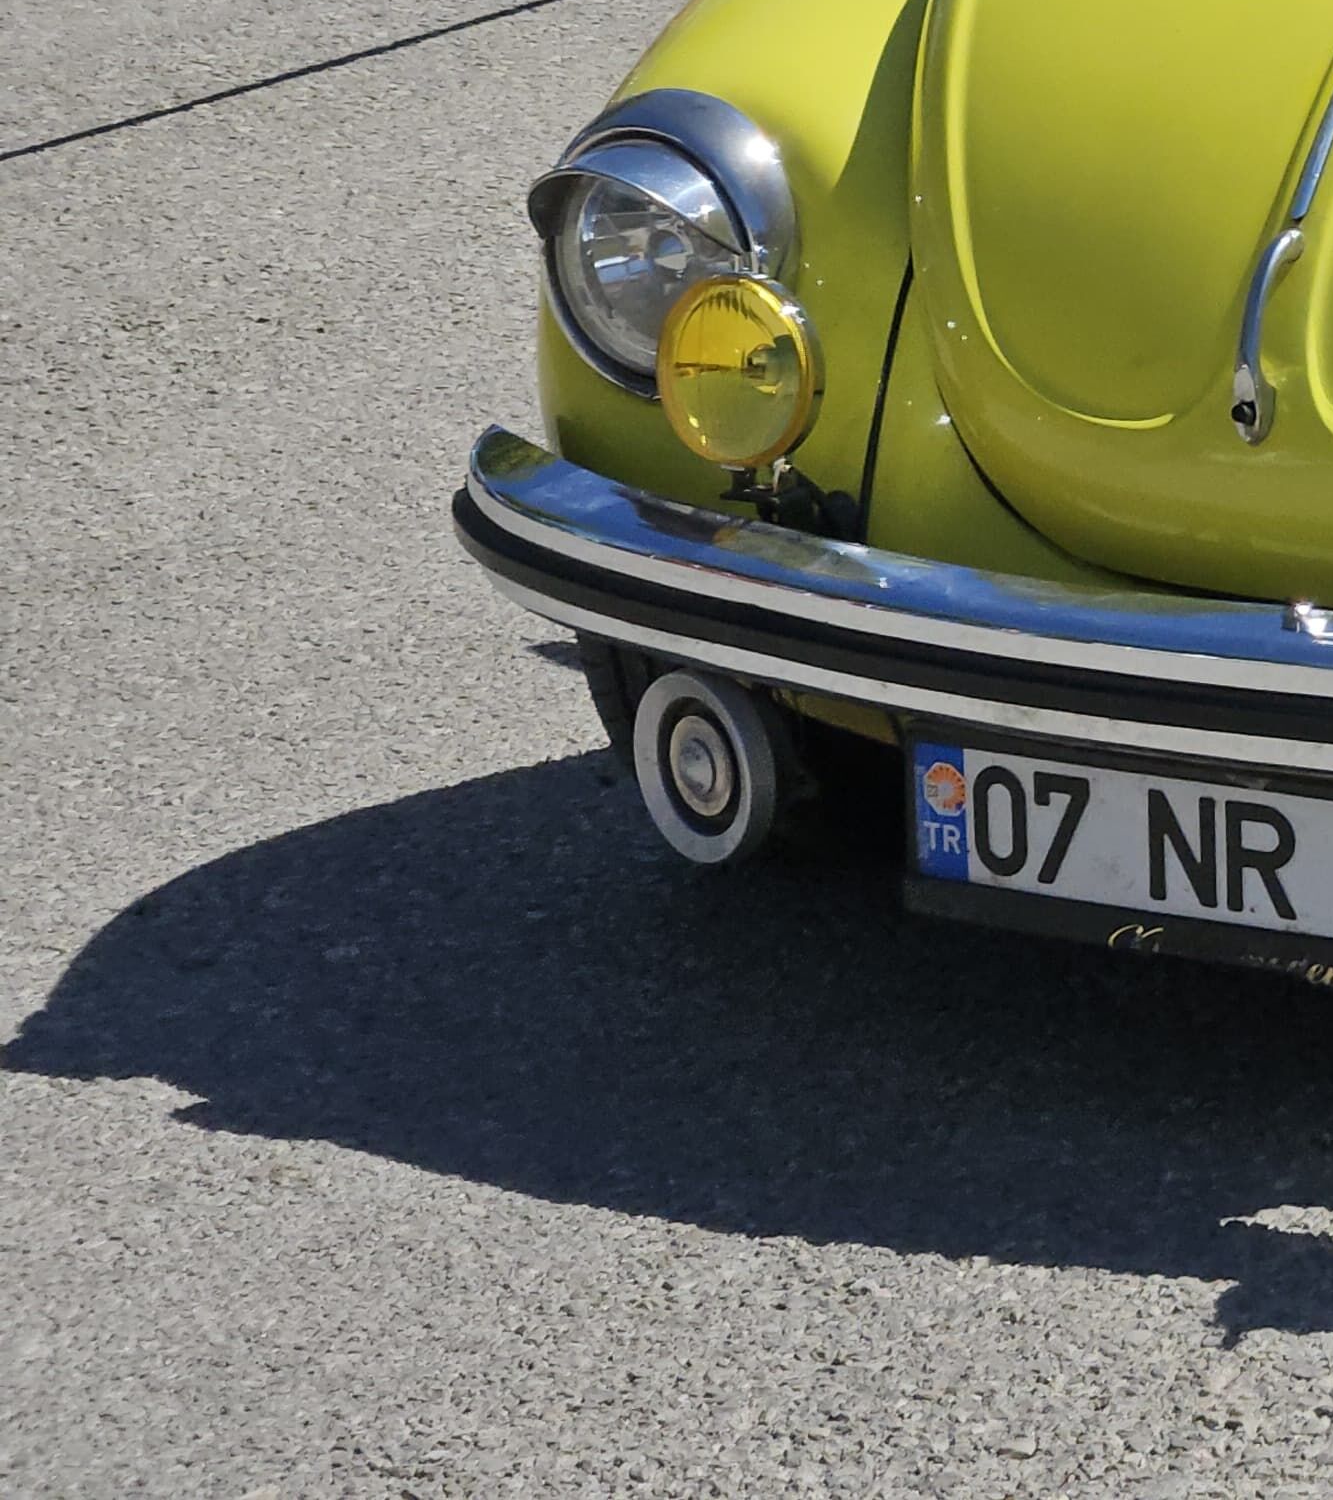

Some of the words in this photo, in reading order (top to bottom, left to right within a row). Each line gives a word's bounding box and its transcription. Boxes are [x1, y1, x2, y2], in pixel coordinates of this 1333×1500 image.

[923, 820, 961, 855] TR
[972, 764, 1091, 885] 07
[1147, 787, 1297, 921] NR
